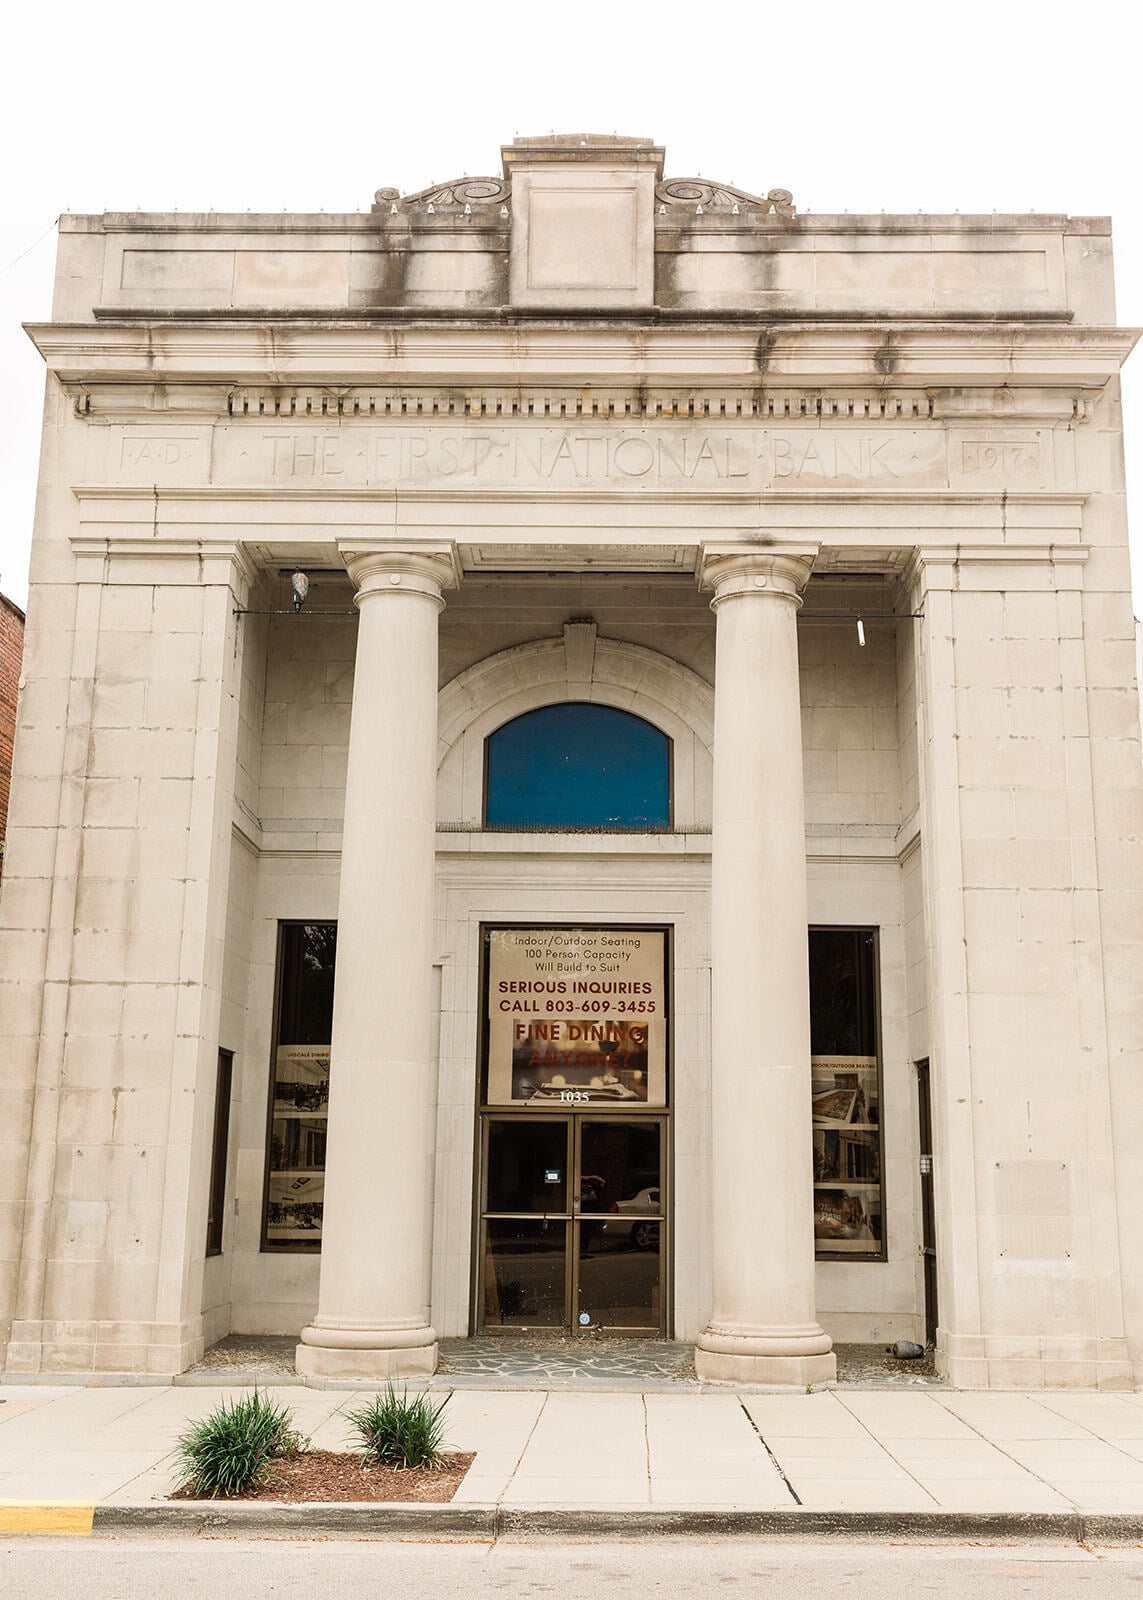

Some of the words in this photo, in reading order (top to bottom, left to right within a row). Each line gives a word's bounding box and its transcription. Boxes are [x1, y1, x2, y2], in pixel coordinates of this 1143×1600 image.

[263, 436, 343, 476] THE
[375, 436, 491, 478] FIRST
[512, 436, 750, 479] NATIONAL
[773, 438, 900, 480] BANK
[515, 936, 598, 948] Indoor/Outdoor
[601, 937, 642, 949] Seating
[525, 949, 542, 959] 100
[545, 949, 580, 960] Person
[583, 949, 632, 961] Capacity
[535, 962, 554, 972] Will
[557, 962, 582, 972] Build
[586, 963, 597, 973] to
[600, 963, 621, 973] Suit
[498, 981, 568, 994] SERIOUS
[572, 981, 653, 995] INQUIRIES
[499, 999, 540, 1012] CALL
[545, 1001, 656, 1013] 803-609-3455
[515, 1024, 561, 1041] FINE
[568, 1025, 646, 1042] DINING
[528, 1051, 631, 1069] ANYONE?
[558, 1091, 590, 1104] 1035
